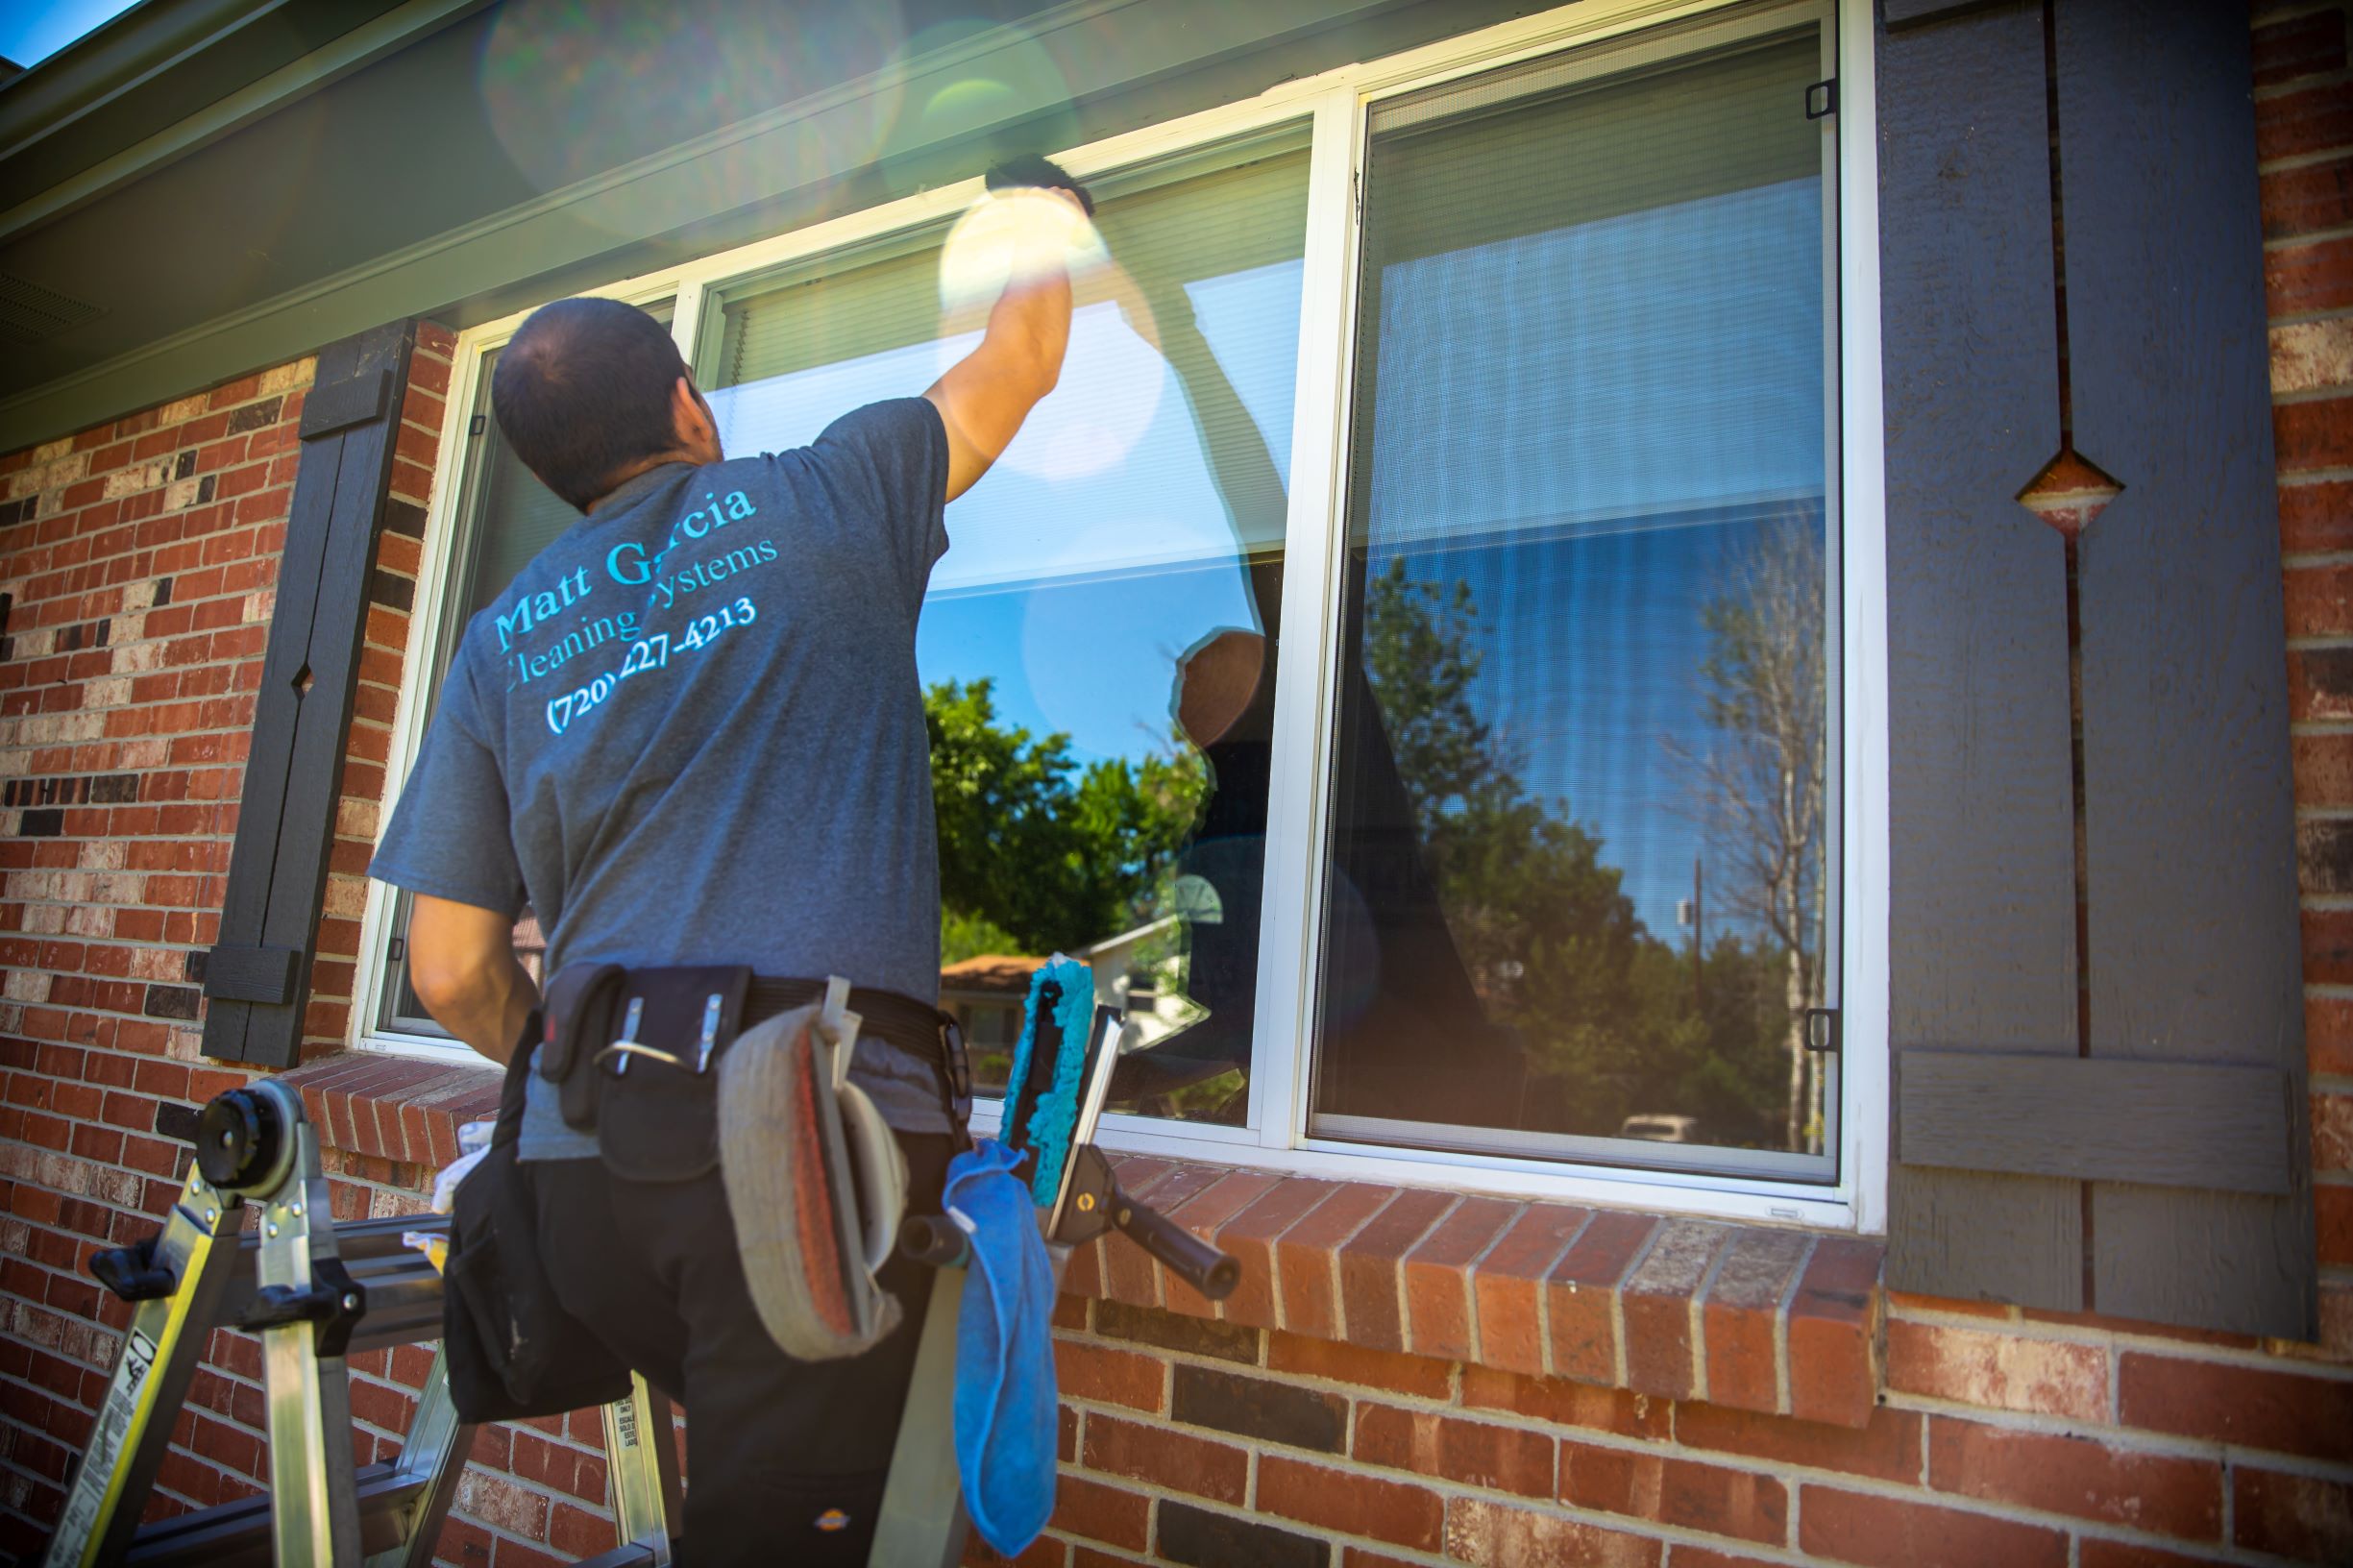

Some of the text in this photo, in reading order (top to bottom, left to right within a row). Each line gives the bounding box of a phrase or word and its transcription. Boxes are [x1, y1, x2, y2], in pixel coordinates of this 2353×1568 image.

[494, 489, 757, 655] Matt Grcia
[506, 539, 779, 693] leaning ystems
